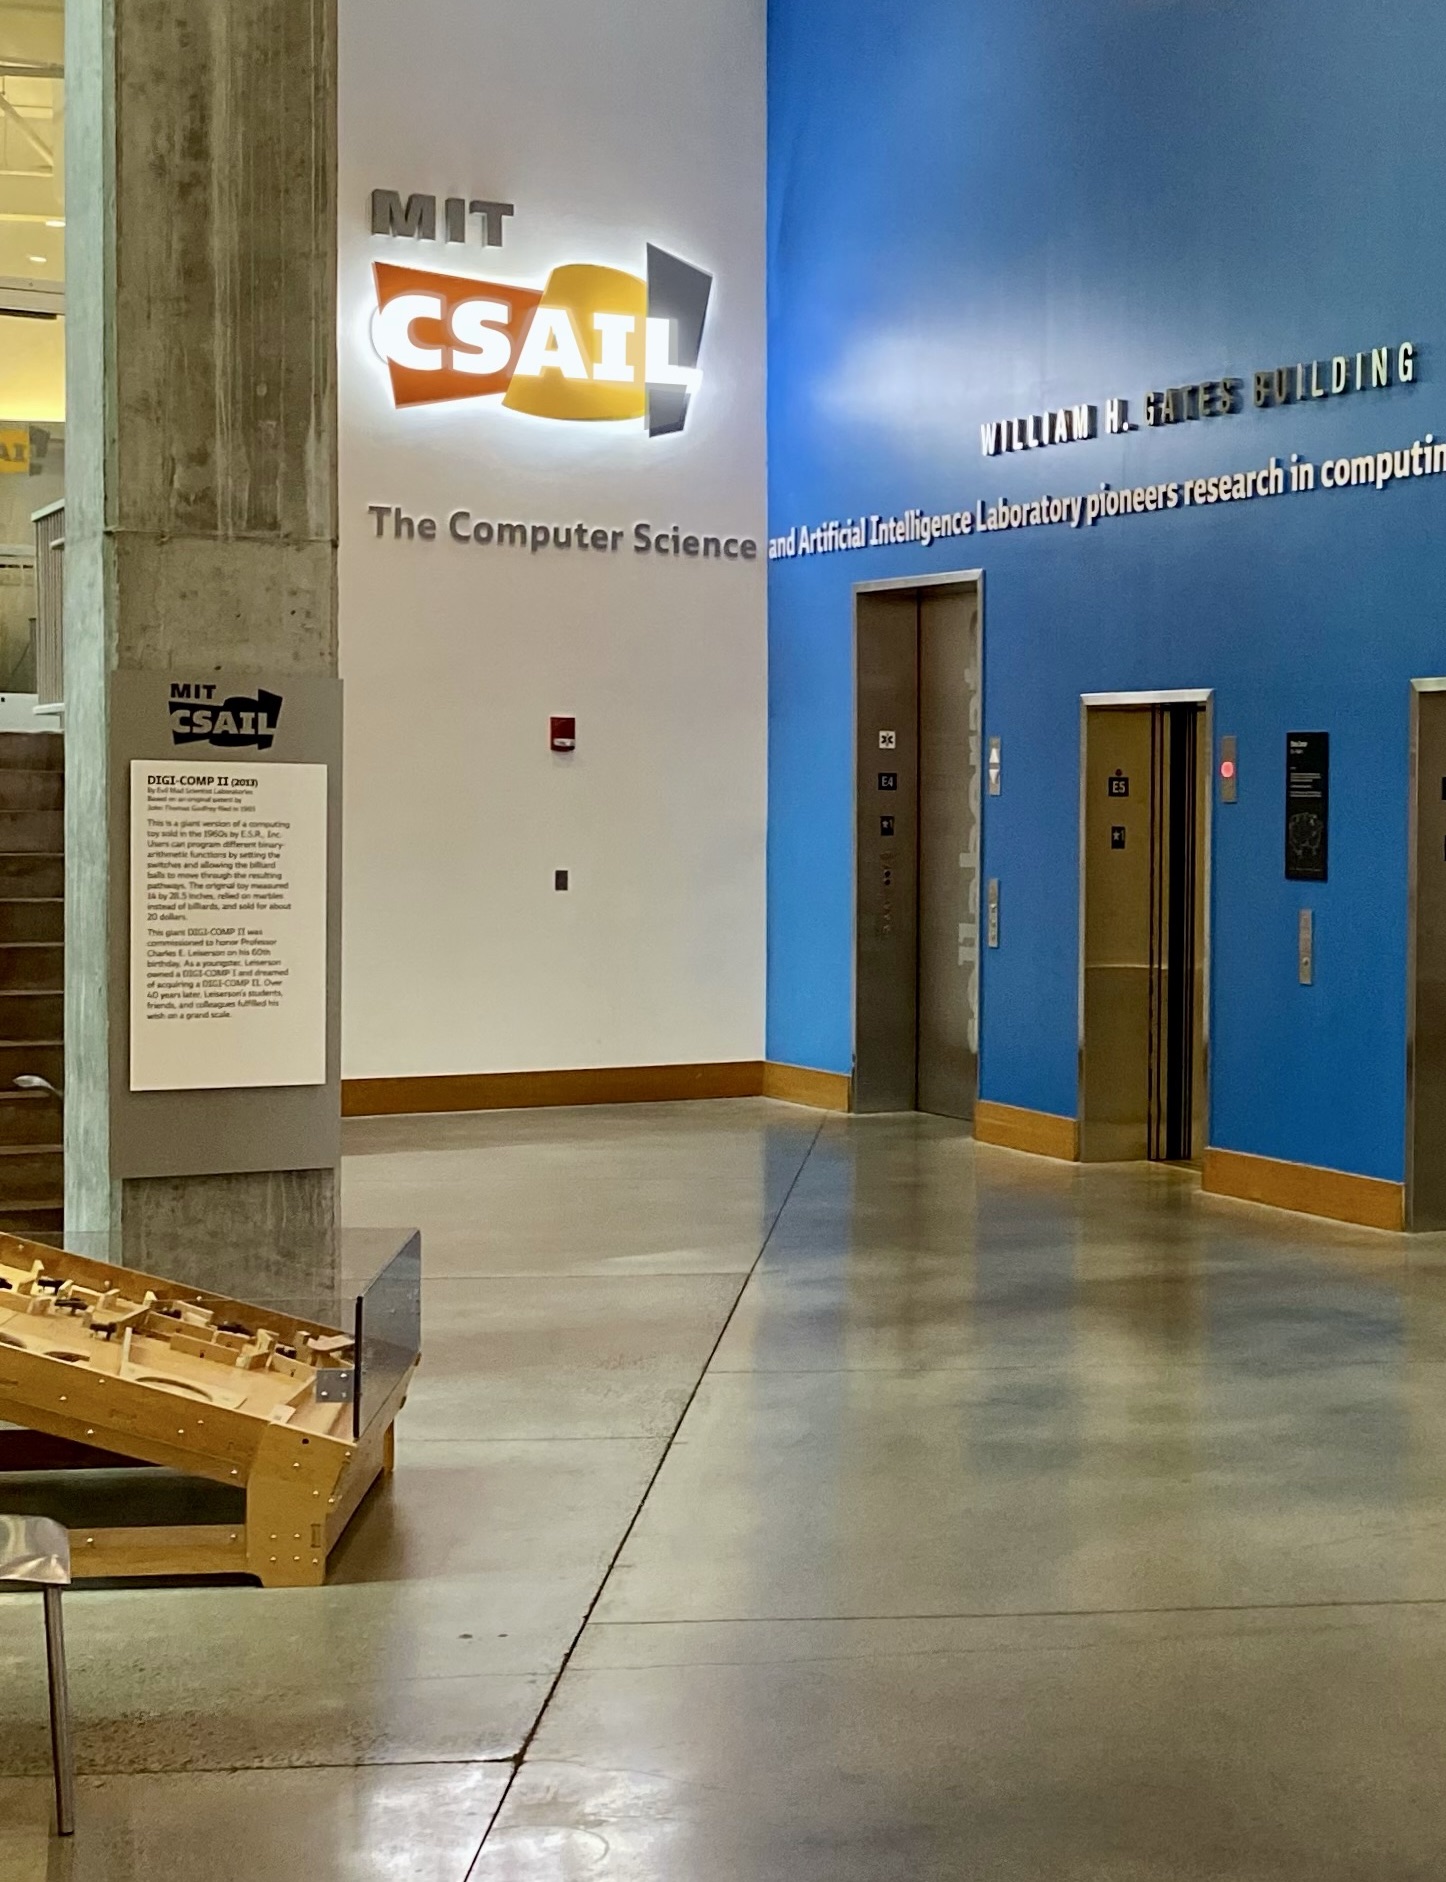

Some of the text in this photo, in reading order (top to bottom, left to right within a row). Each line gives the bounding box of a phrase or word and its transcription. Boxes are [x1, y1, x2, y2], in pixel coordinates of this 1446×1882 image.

[371, 188, 514, 248] MIT
[371, 294, 703, 385] CSAIL
[980, 341, 1415, 456] WILLIAM H. GATES BUILDING
[368, 505, 437, 541] The
[449, 511, 624, 553] Computer
[634, 523, 758, 560] Science
[768, 527, 795, 559] and
[798, 517, 867, 555] Artificial
[870, 509, 973, 547] Intelligence
[976, 495, 1083, 532] Laboratory
[1086, 483, 1178, 527] pioneers
[1183, 458, 1284, 504] research
[1291, 454, 1314, 491] in
[170, 683, 217, 699] MIT
[170, 709, 276, 735] CSAIL
[147, 775, 214, 785] DIGI-COMP
[217, 776, 229, 786] II
[881, 776, 894, 787] E4
[1112, 780, 1125, 793] E5
